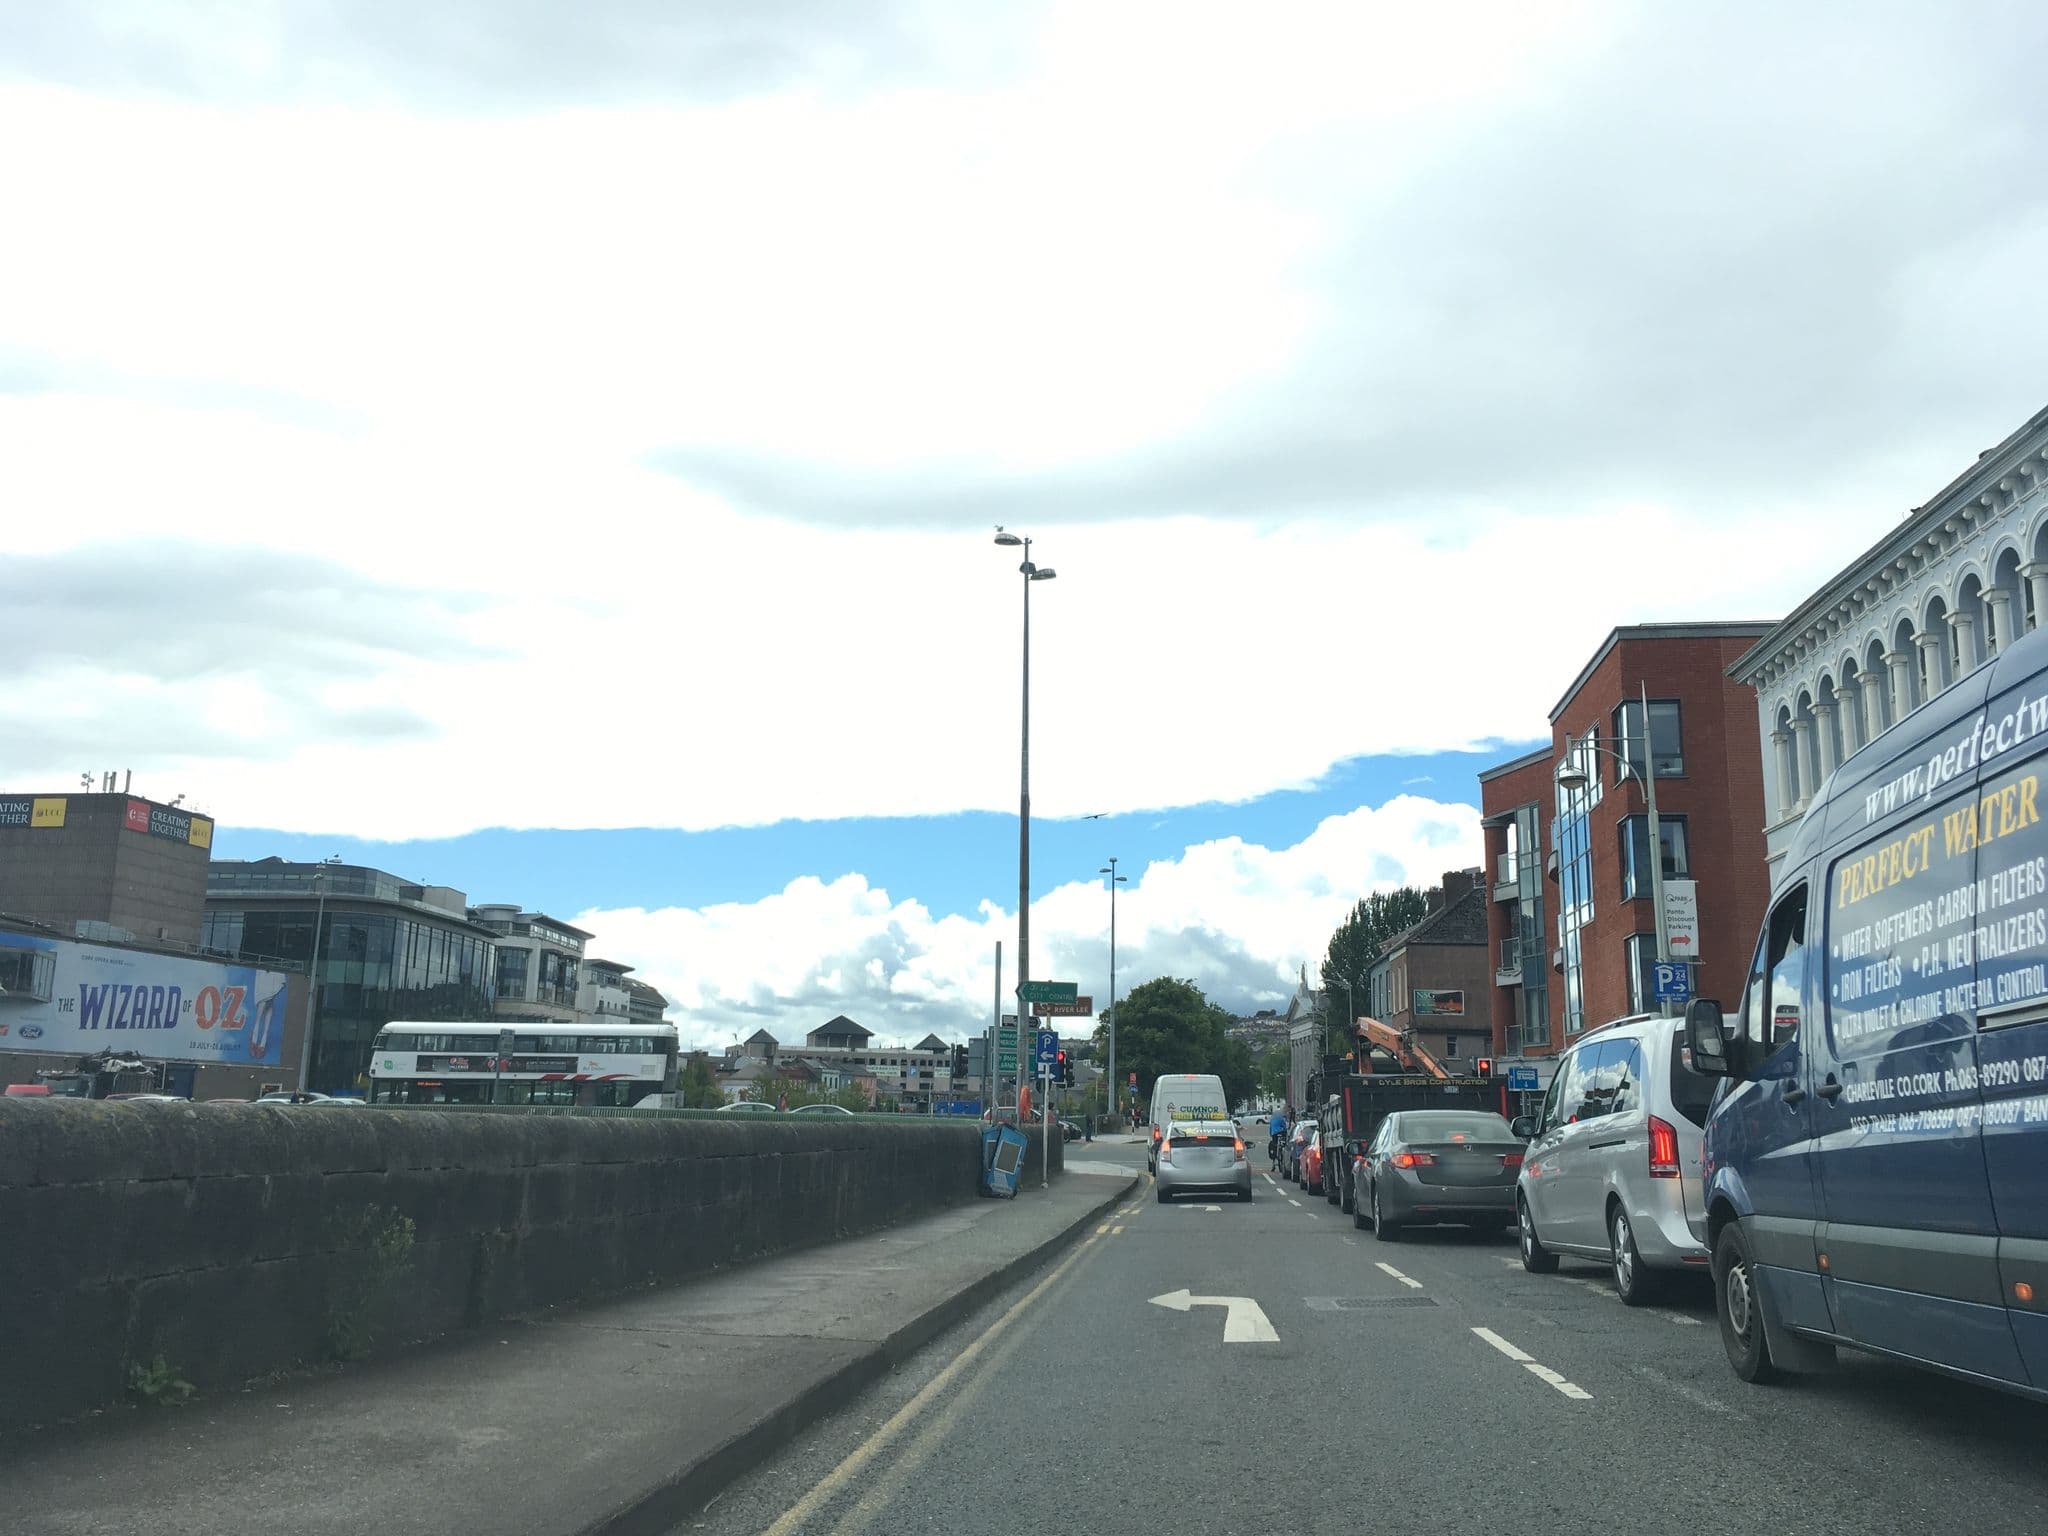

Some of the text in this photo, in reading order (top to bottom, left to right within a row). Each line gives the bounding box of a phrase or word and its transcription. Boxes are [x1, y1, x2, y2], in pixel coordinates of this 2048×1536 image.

[151, 821, 188, 841] TOGETHER
[152, 810, 190, 829] CREATING
[1839, 775, 2040, 909] PERFECT WATER
[1842, 856, 2045, 962] WATER SOFTENERS CARBON FILTERS
[1841, 908, 2046, 1002] IRON FILTERS P.H. NEUTRALIZERS
[58, 983, 248, 1031] THE WIZARD OF OZ
[1054, 1006, 1089, 1014] RIVER LEE
[1841, 964, 2048, 1039] ULTRA VIOLET & CHLORINE BACTERIA CONTROL
[1429, 1078, 1488, 1086] CONSTRUCTION
[1846, 1078, 1895, 1104] CHARLEVILLE
[1897, 1071, 1942, 1098] CO.CORK
[1180, 1105, 1219, 1113] CUMNOR
[1850, 1117, 1870, 1135] ALSO
[1871, 1111, 1896, 1133] TRALEE
